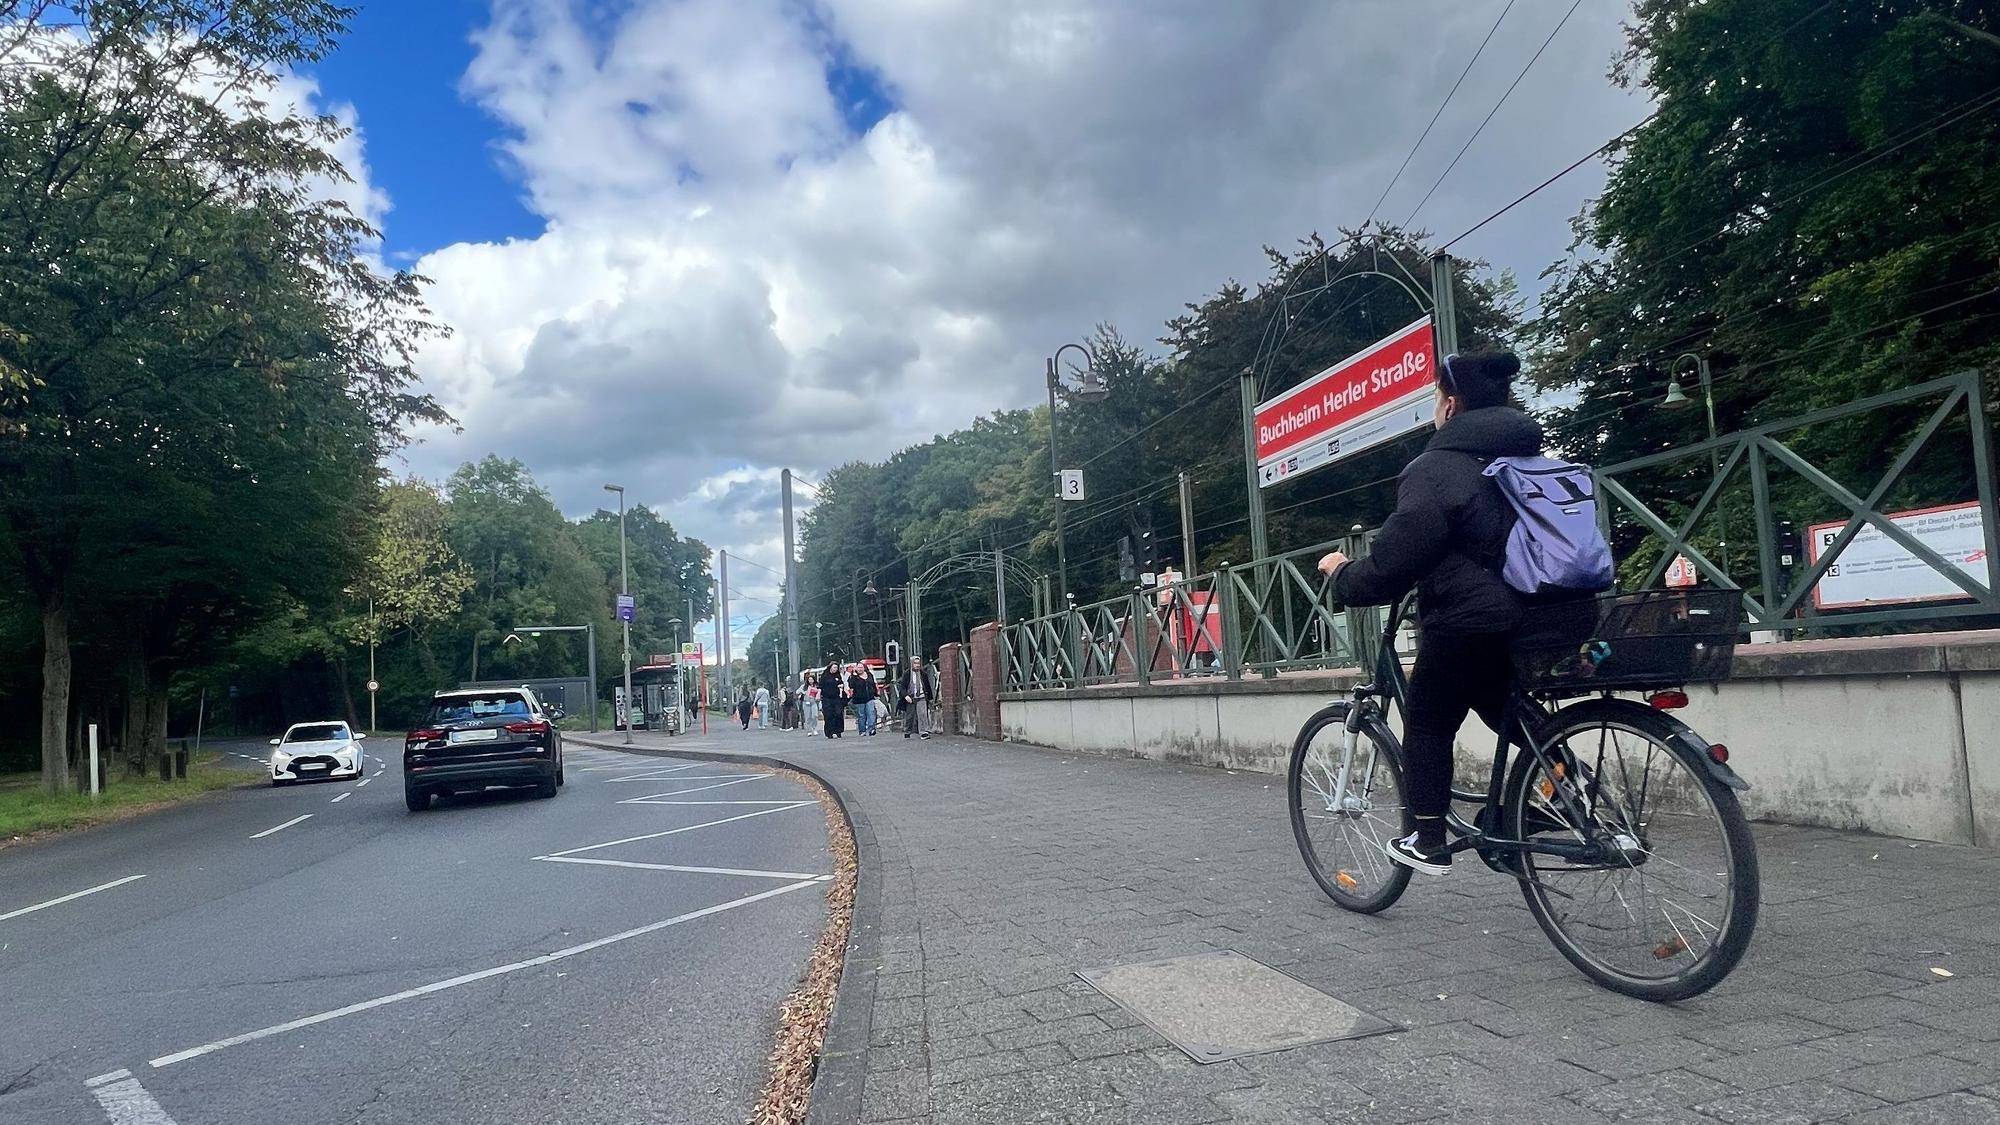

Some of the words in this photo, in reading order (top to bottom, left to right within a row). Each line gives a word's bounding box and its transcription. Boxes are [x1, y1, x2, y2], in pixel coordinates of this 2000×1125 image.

[1260, 405, 1321, 446] Buchheim
[1323, 379, 1369, 416] Herler
[1370, 351, 1427, 393] Straße
[1069, 480, 1079, 494] 3
[1828, 565, 1840, 576] 13
